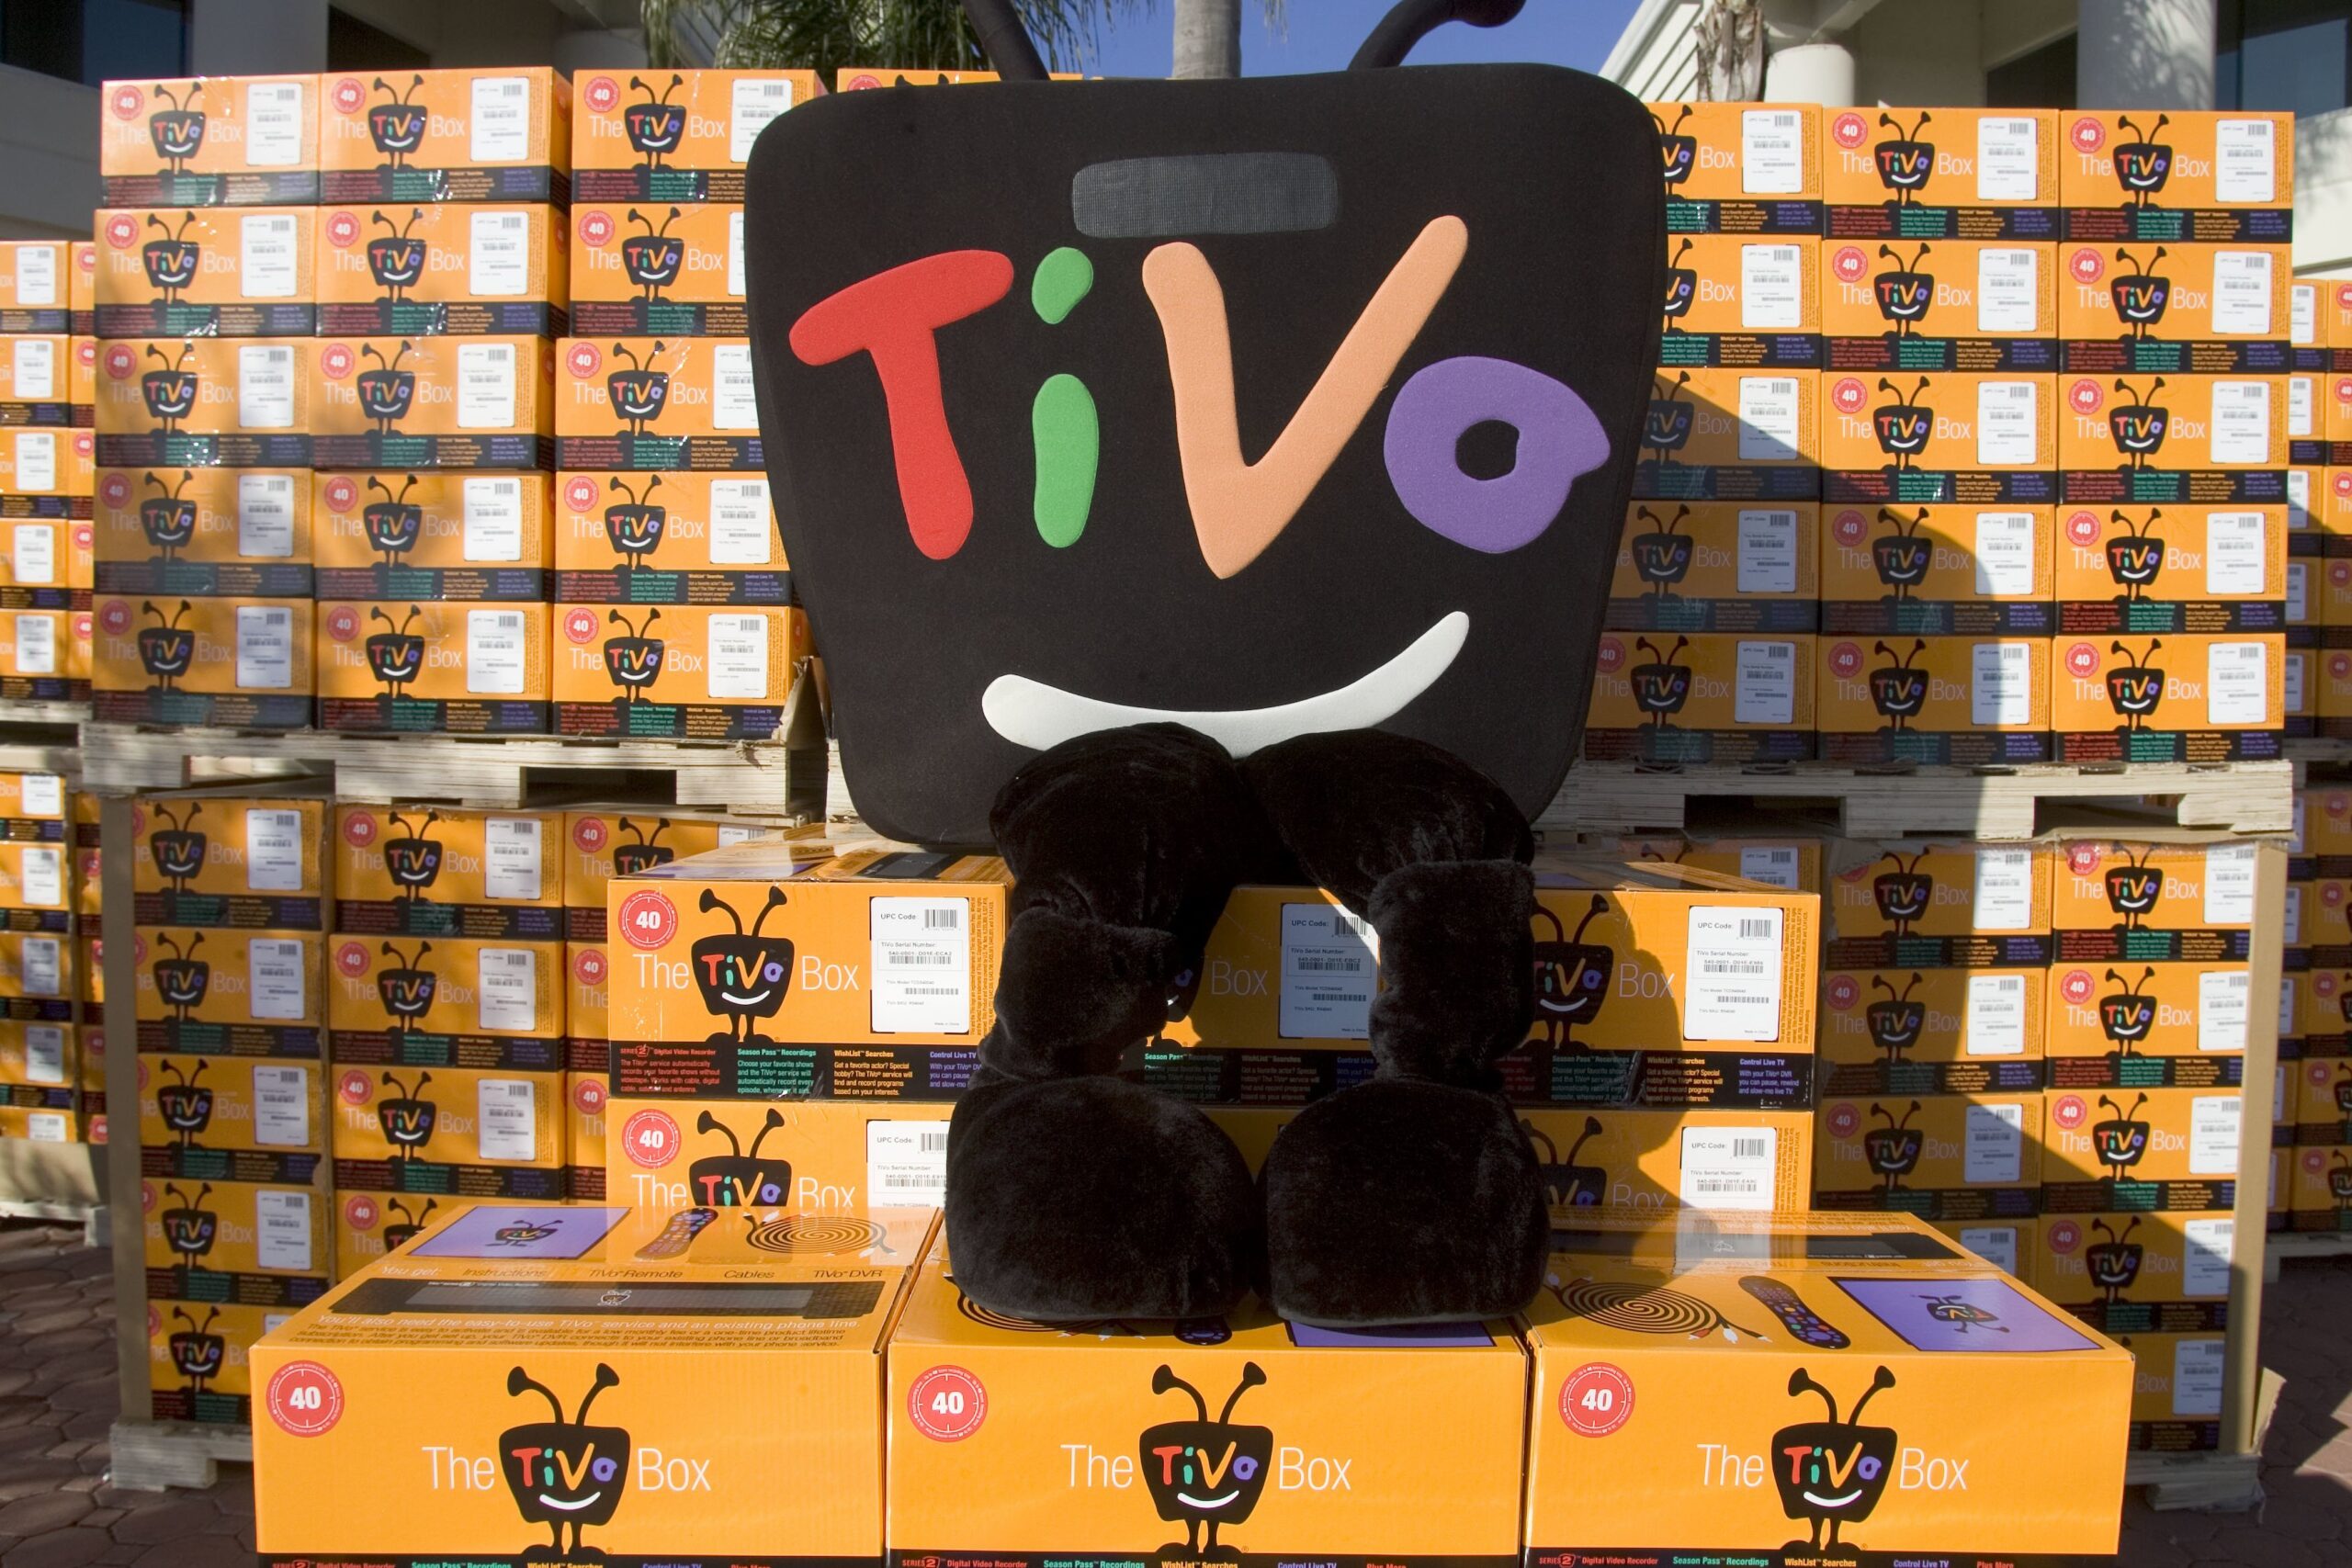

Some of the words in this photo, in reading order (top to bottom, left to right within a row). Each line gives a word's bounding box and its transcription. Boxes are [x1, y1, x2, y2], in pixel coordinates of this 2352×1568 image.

[341, 90, 356, 101] 40
[594, 89, 609, 100] 40
[334, 116, 368, 139] The
[372, 113, 423, 138] TiVo
[431, 116, 465, 137] Box
[588, 114, 623, 137] The
[630, 112, 680, 137] TiVo
[690, 116, 725, 138] Box
[1843, 125, 1857, 136] 40
[2081, 130, 2095, 141] 40
[1839, 152, 1872, 174] The
[1881, 150, 1928, 172] TiVo
[1939, 152, 1973, 175] Box
[2078, 154, 2110, 176] The
[2120, 152, 2165, 175] TiVo
[2176, 155, 2210, 176] Box
[589, 223, 604, 233] 40
[586, 246, 621, 269] The
[628, 245, 678, 269] TiVo
[688, 248, 722, 270] Box
[2080, 261, 2095, 271] 40
[2077, 285, 2110, 309] The
[2117, 284, 2164, 308] TiVo
[2174, 287, 2206, 309] Box
[576, 355, 591, 366] 40
[573, 381, 606, 404] The
[613, 379, 663, 403] TiVo
[673, 382, 707, 404] Box
[788, 215, 1611, 580] TiVo
[1843, 390, 1857, 400] 40
[2079, 391, 2093, 402] 40
[1838, 415, 1872, 438] The
[1880, 413, 1927, 437] TiVo
[1937, 417, 1971, 439] Box
[2075, 415, 2109, 438] The
[2115, 415, 2162, 437] TiVo
[2172, 417, 2205, 438] Box
[574, 489, 588, 499] 40
[570, 514, 604, 537] The
[610, 513, 660, 537] TiVo
[670, 515, 704, 537] Box
[2076, 524, 2090, 534] 40
[2072, 547, 2106, 570] The
[2111, 547, 2158, 569] TiVo
[2167, 550, 2200, 570] Box
[574, 620, 588, 631] 40
[570, 648, 603, 670] The
[609, 647, 659, 671] TiVo
[668, 650, 702, 671] Box
[2075, 655, 2089, 665] 40
[2073, 678, 2106, 700] The
[2112, 678, 2158, 699] TiVo
[2168, 678, 2200, 699] Box
[637, 911, 661, 929] 40
[632, 953, 689, 989] The
[701, 951, 784, 989] TiVo
[802, 955, 858, 990] Box
[1211, 961, 1268, 996] Box
[1619, 963, 1675, 998] Box
[2066, 1005, 2099, 1026] The
[2105, 1003, 2150, 1025] TiVo
[2159, 1005, 2191, 1025] Box
[738, 1048, 761, 1056] Season
[781, 1049, 817, 1058] Recordings
[1762, 1058, 1776, 1066] Live
[639, 1131, 663, 1147] 40
[631, 1174, 686, 1207] The
[698, 1172, 781, 1206] TiVo
[798, 1177, 854, 1208] Box
[1613, 1184, 1669, 1207] Box
[382, 1267, 408, 1276] You
[463, 1268, 547, 1278] Instructions
[626, 1269, 683, 1279] Remote
[724, 1270, 775, 1279] Cables
[849, 1269, 882, 1278] DVR
[361, 1315, 393, 1325] also
[397, 1317, 434, 1326] need
[438, 1317, 460, 1326] the
[465, 1319, 553, 1328] easy-to-use
[603, 1320, 656, 1328] service
[658, 1320, 688, 1328] and
[714, 1321, 775, 1331] existing
[777, 1321, 826, 1330] phone
[290, 1387, 321, 1409] 40
[933, 1392, 964, 1414] 40
[1582, 1389, 1612, 1411] 40
[422, 1447, 494, 1490] The
[512, 1441, 617, 1491] TiVo
[638, 1448, 710, 1492] Box
[1060, 1444, 1133, 1488] The
[1152, 1441, 1258, 1490] TiVo
[1279, 1448, 1351, 1491] Box
[1697, 1444, 1764, 1487] The
[1784, 1442, 1881, 1489] TiVo
[1900, 1448, 1969, 1490] Box
[1044, 1560, 1072, 1568] Season
[1581, 1556, 1604, 1566] Digital
[1606, 1557, 1625, 1565] Video
[1627, 1557, 1659, 1565] Recorder
[1673, 1556, 1700, 1565] Season
[1726, 1557, 1770, 1567] Recordings
[1823, 1558, 1857, 1567] Searches
[1894, 1559, 1921, 1567] Control
[1923, 1559, 1938, 1567] Live
